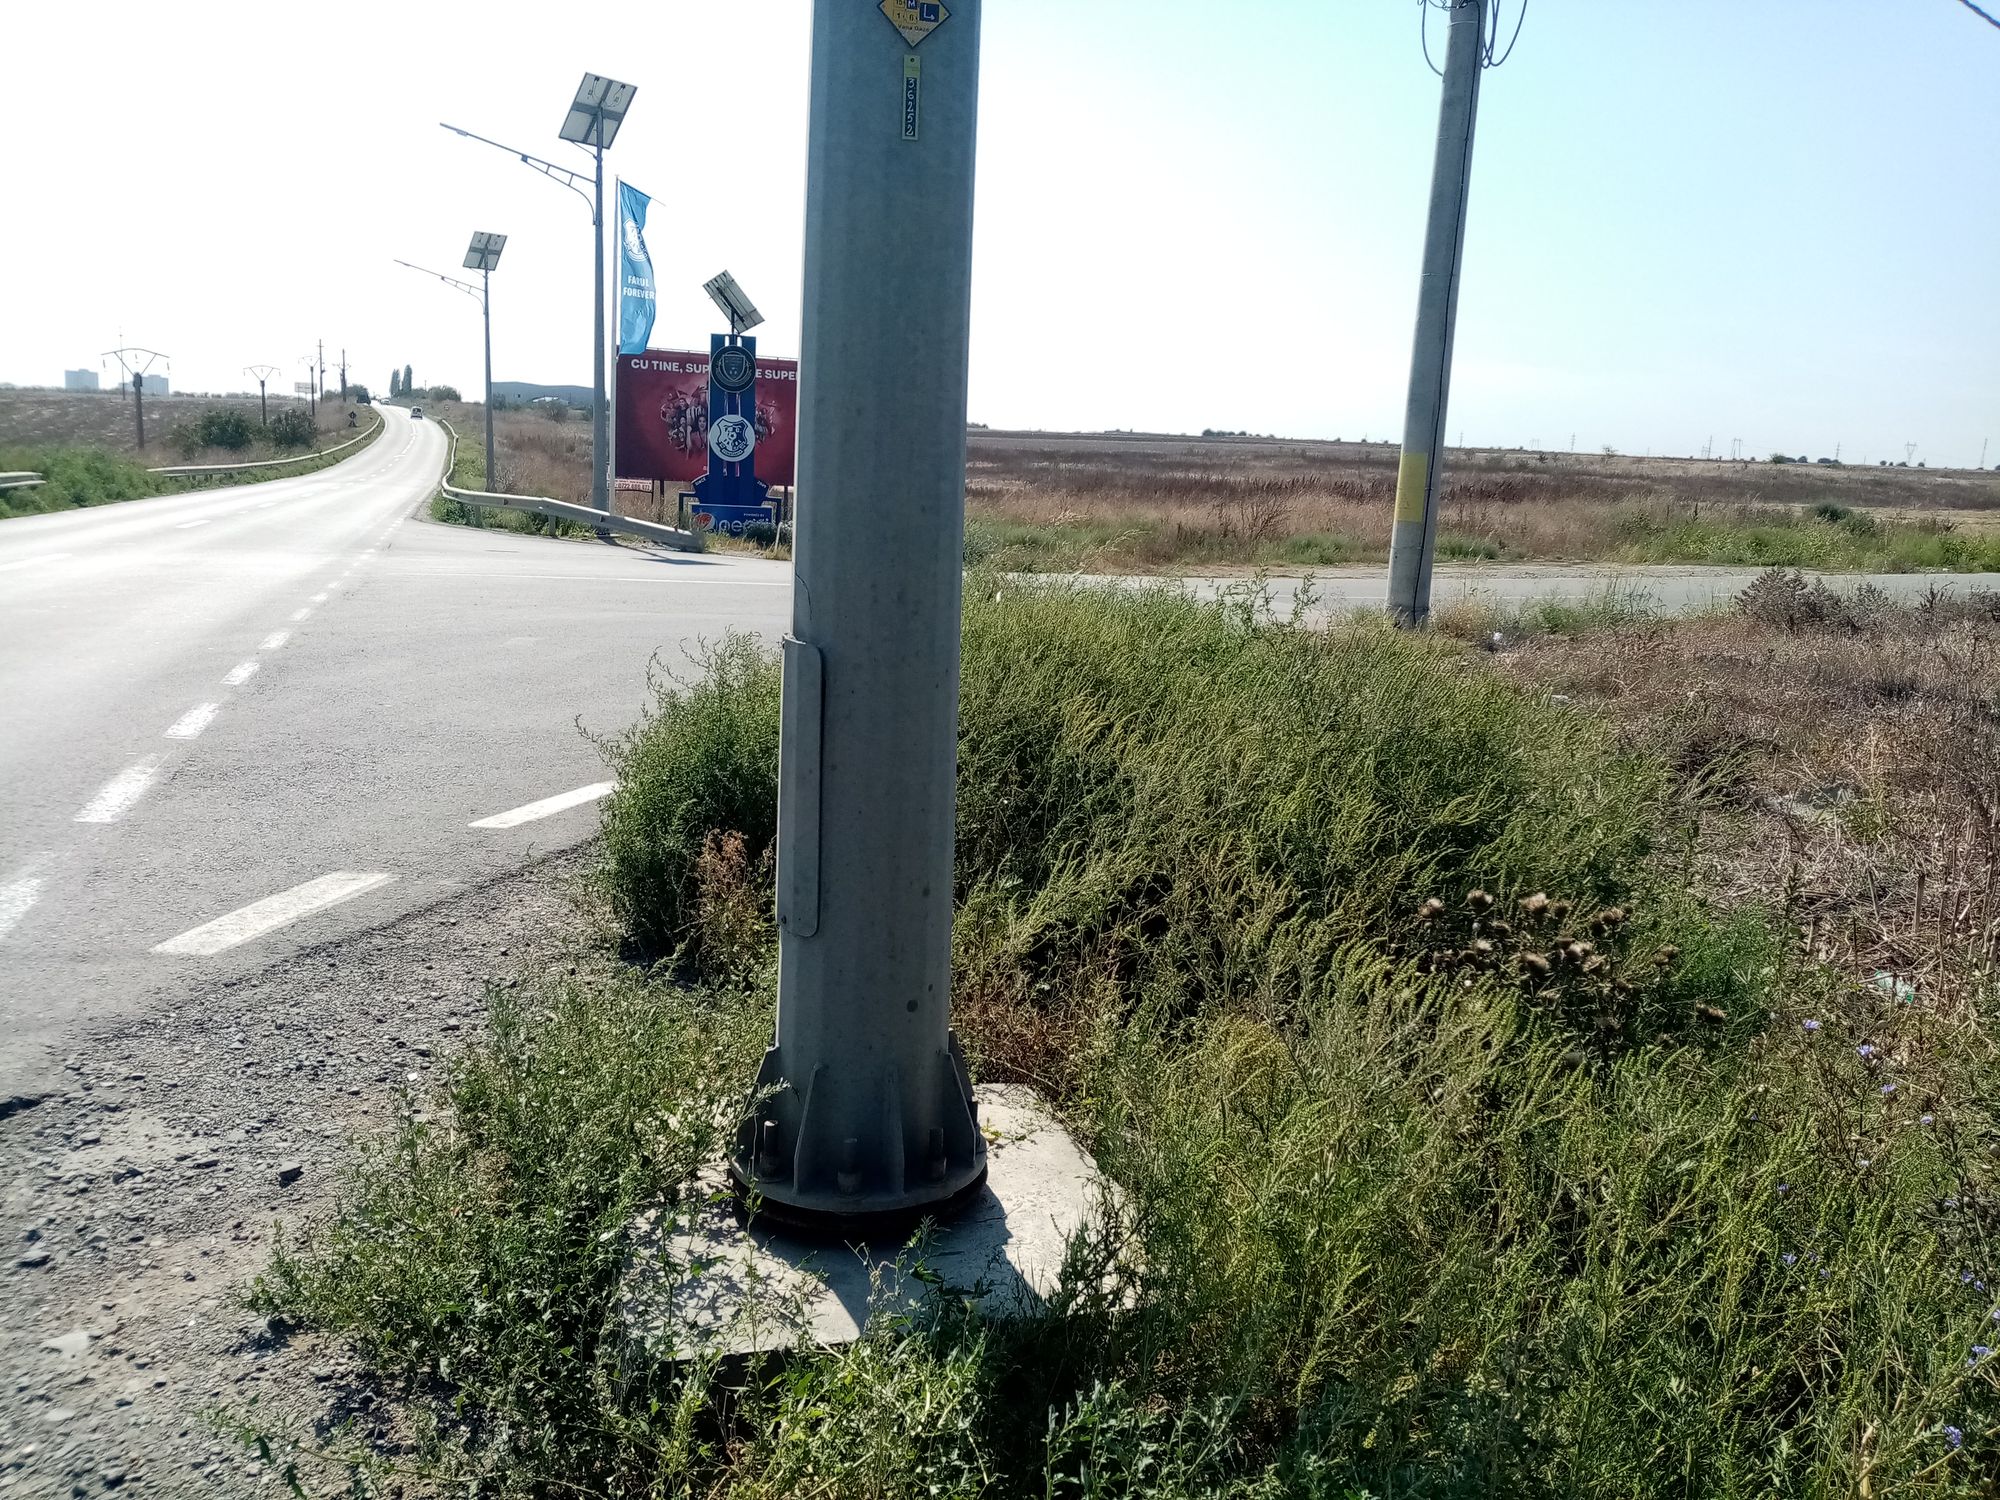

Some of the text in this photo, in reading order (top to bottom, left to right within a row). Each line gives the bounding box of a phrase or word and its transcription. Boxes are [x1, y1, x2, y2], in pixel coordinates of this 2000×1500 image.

[906, 78, 915, 136] 36252
[627, 275, 650, 287] FARUL
[623, 286, 655, 300] FOREVER
[631, 358, 649, 370] CU
[651, 360, 683, 374] TINE,
[685, 363, 709, 374] SUP
[765, 370, 797, 381] SUPE
